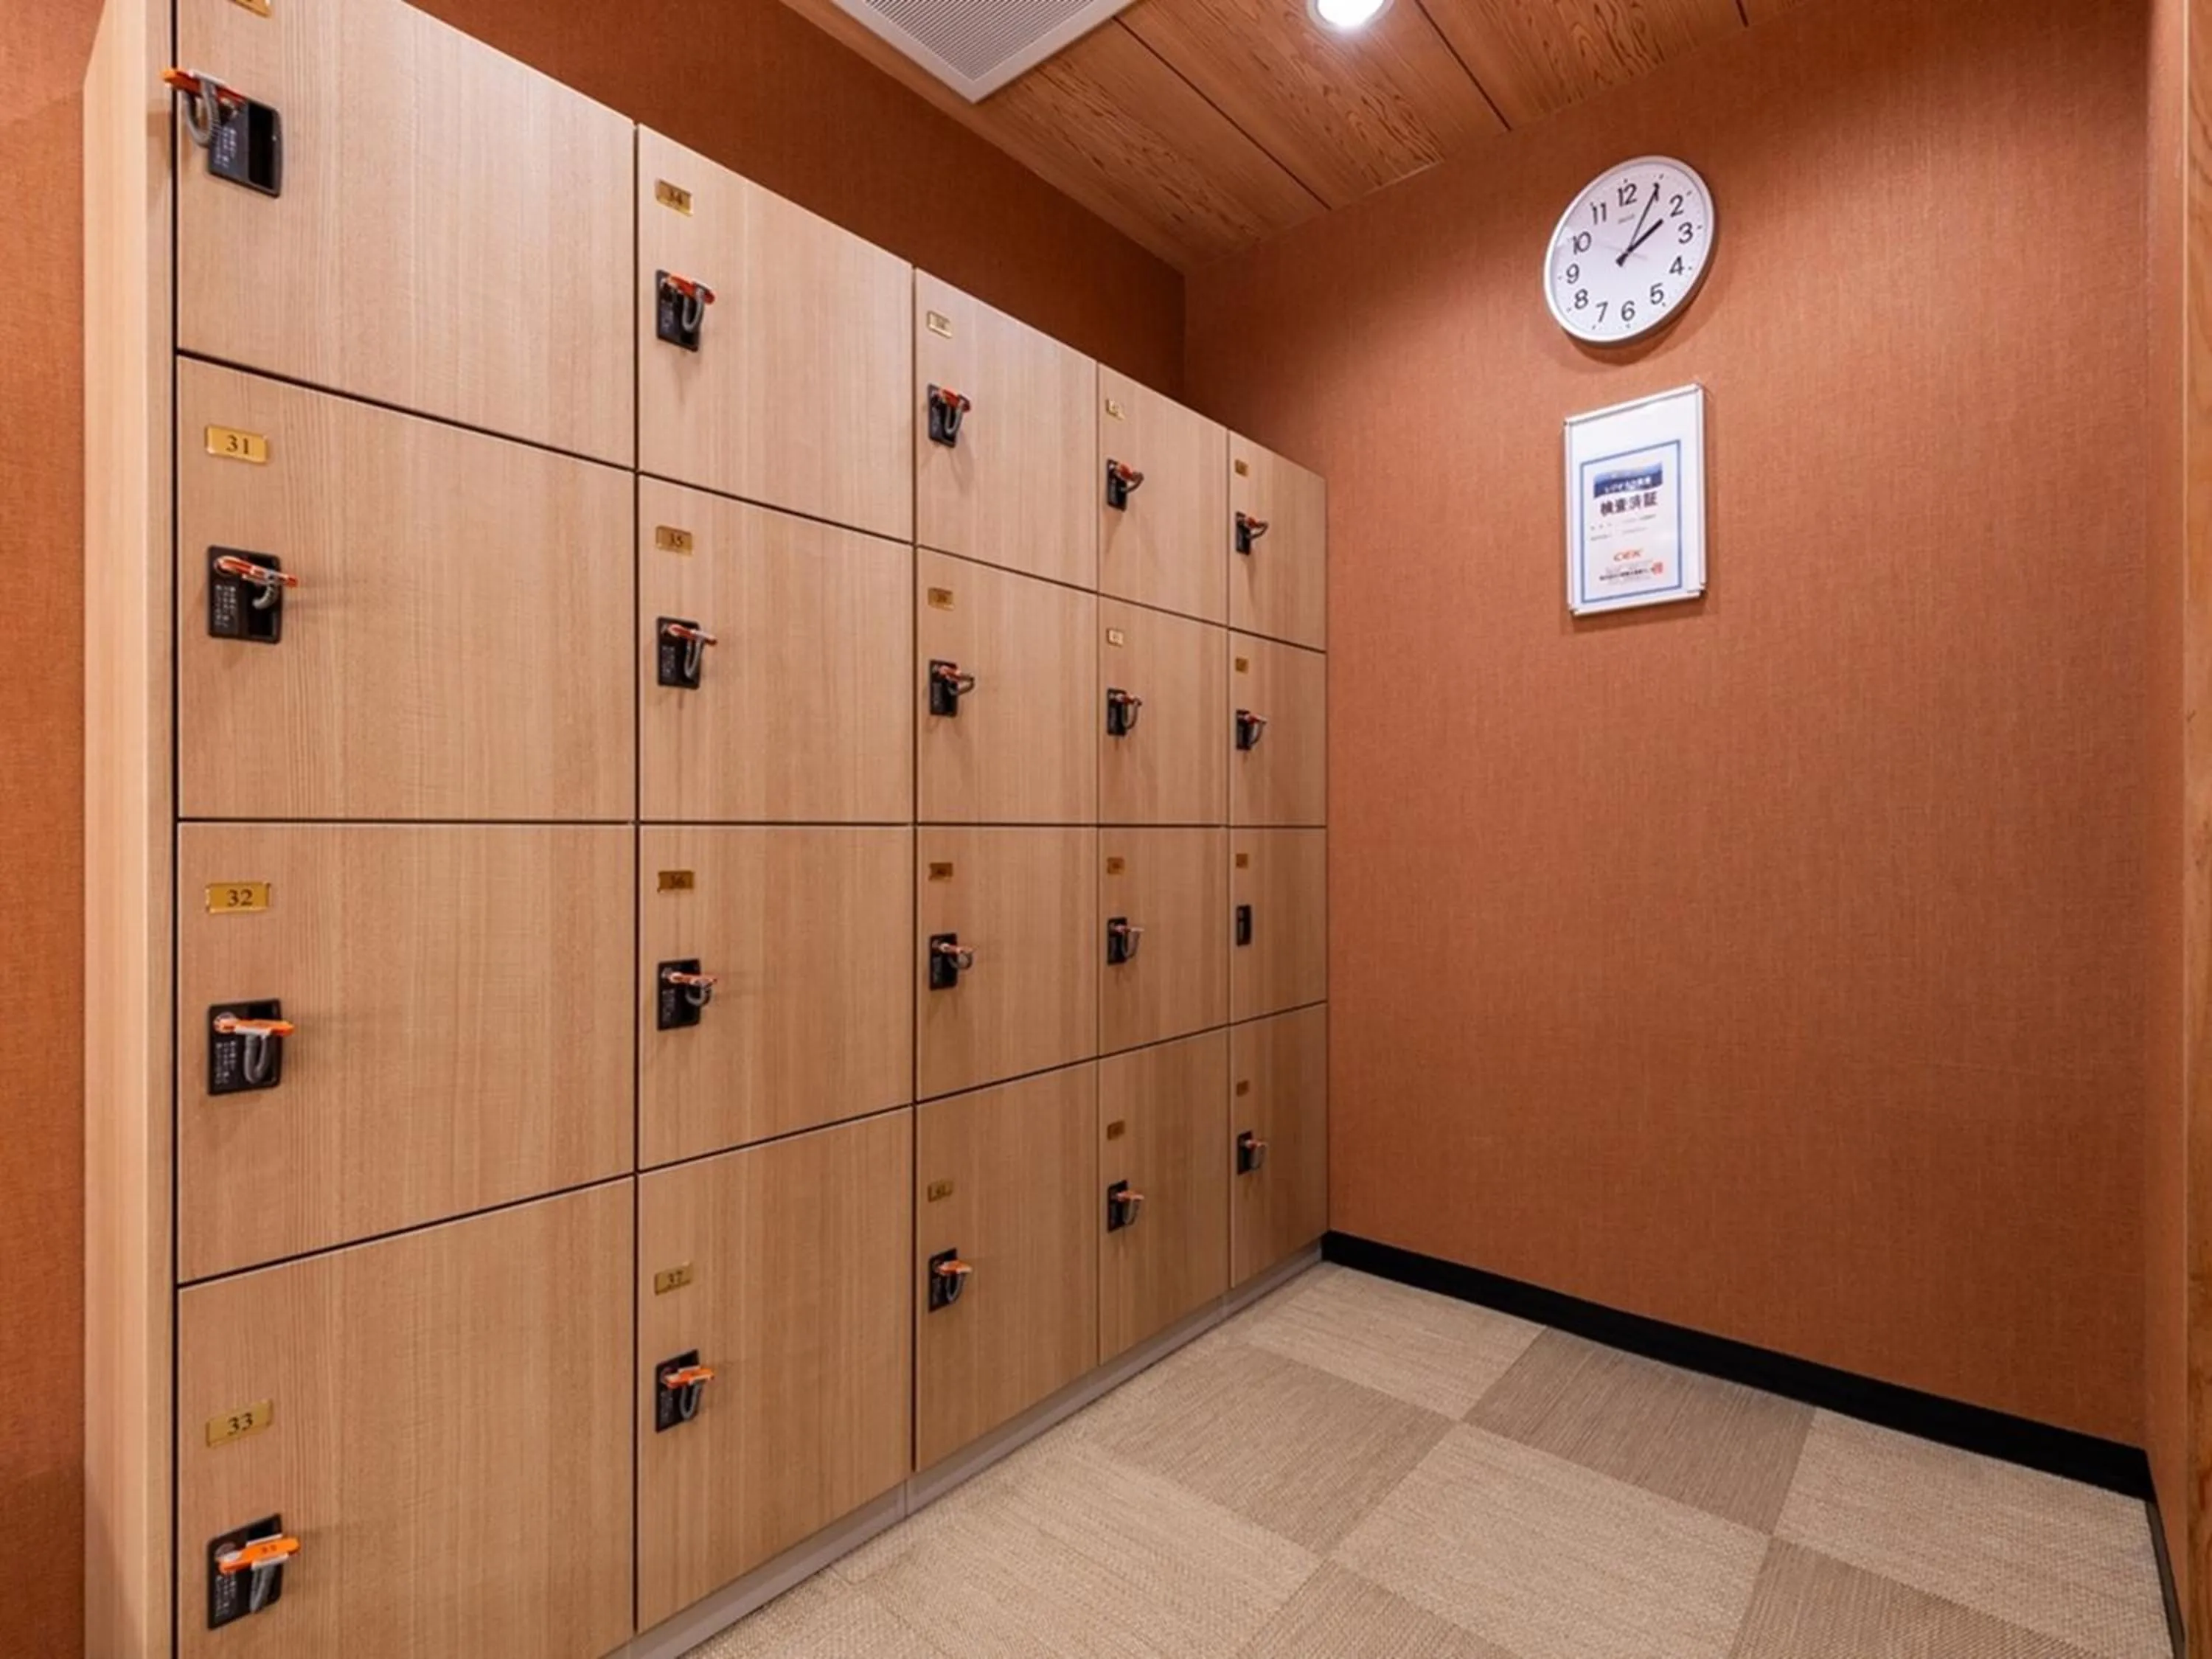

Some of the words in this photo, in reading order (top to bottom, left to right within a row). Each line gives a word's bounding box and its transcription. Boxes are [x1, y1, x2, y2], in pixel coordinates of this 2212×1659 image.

[1616, 183, 1638, 207] 12
[1669, 194, 1683, 218] 2
[1590, 201, 1607, 225] 11
[1572, 231, 1592, 255] 10
[1677, 222, 1693, 244] 3
[1566, 263, 1580, 284] 9
[1669, 256, 1684, 276] 4
[1573, 288, 1589, 310] 8
[1649, 283, 1664, 305] 5
[1596, 302, 1609, 323] 7
[1621, 301, 1635, 321] 6
[225, 434, 249, 454] 31
[226, 888, 254, 908] 32
[226, 1411, 254, 1437] 33
